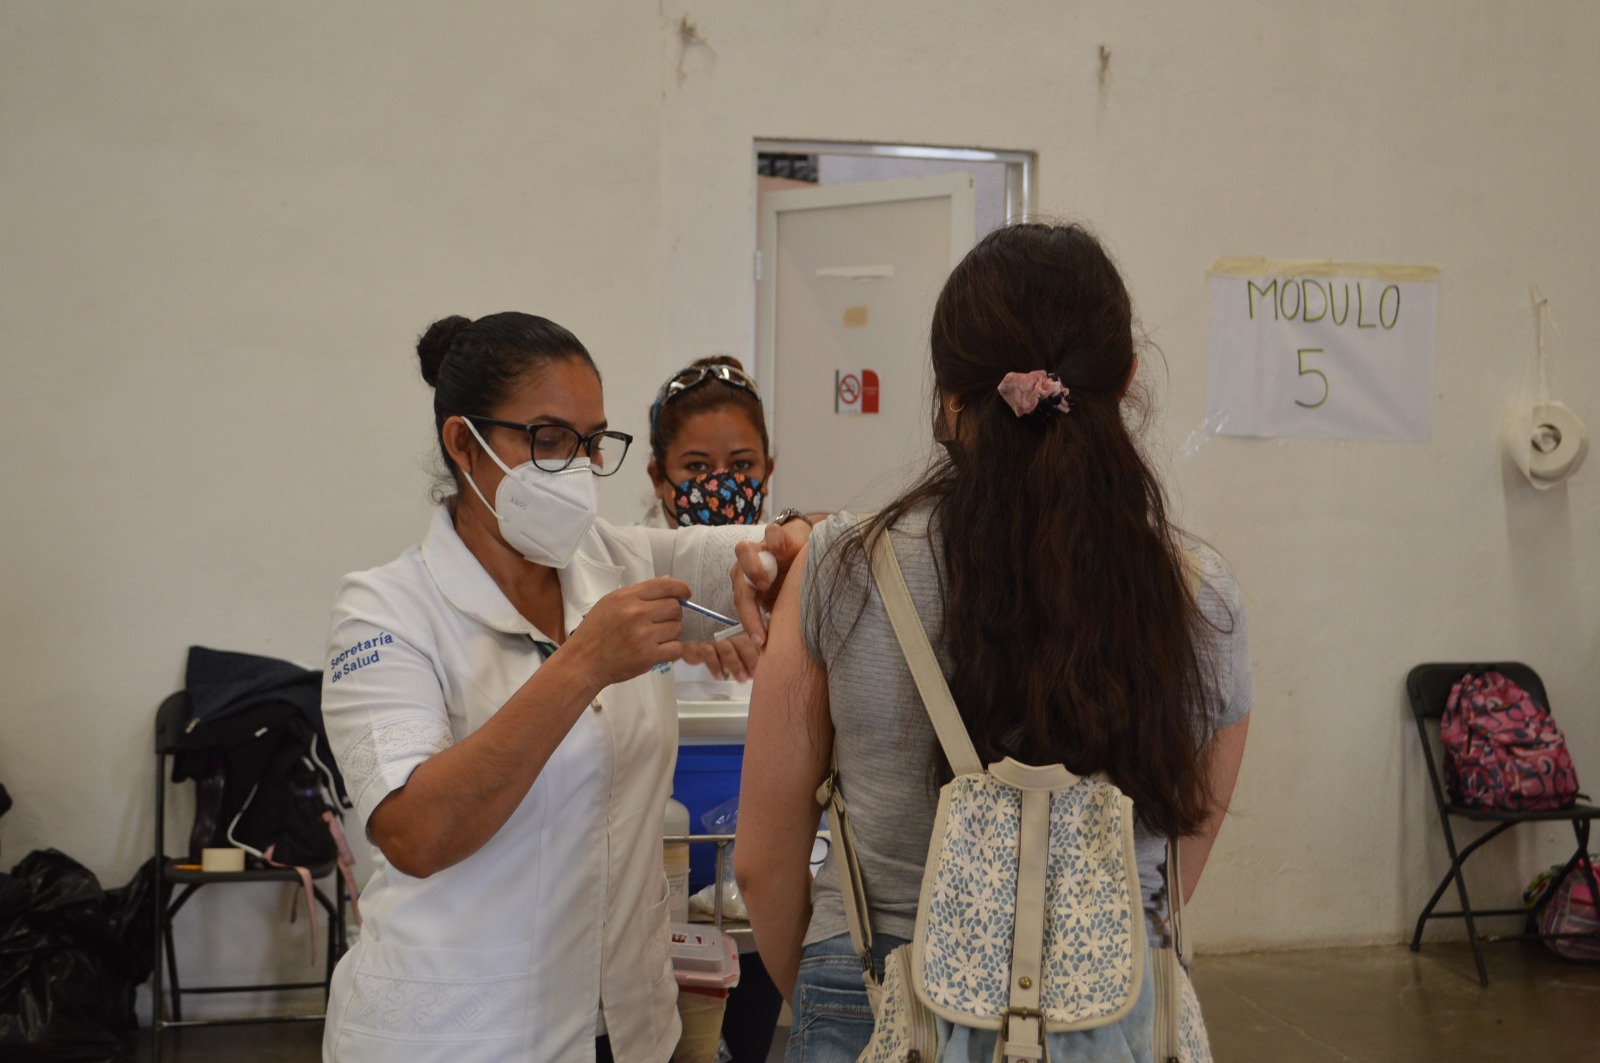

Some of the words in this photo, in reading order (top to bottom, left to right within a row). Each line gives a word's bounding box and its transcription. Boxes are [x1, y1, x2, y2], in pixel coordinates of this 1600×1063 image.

[1247, 278, 1400, 330] MODULO
[1295, 348, 1329, 409] 5
[330, 632, 394, 670] Secretaría
[332, 671, 342, 683] de
[343, 650, 380, 675] Salud
